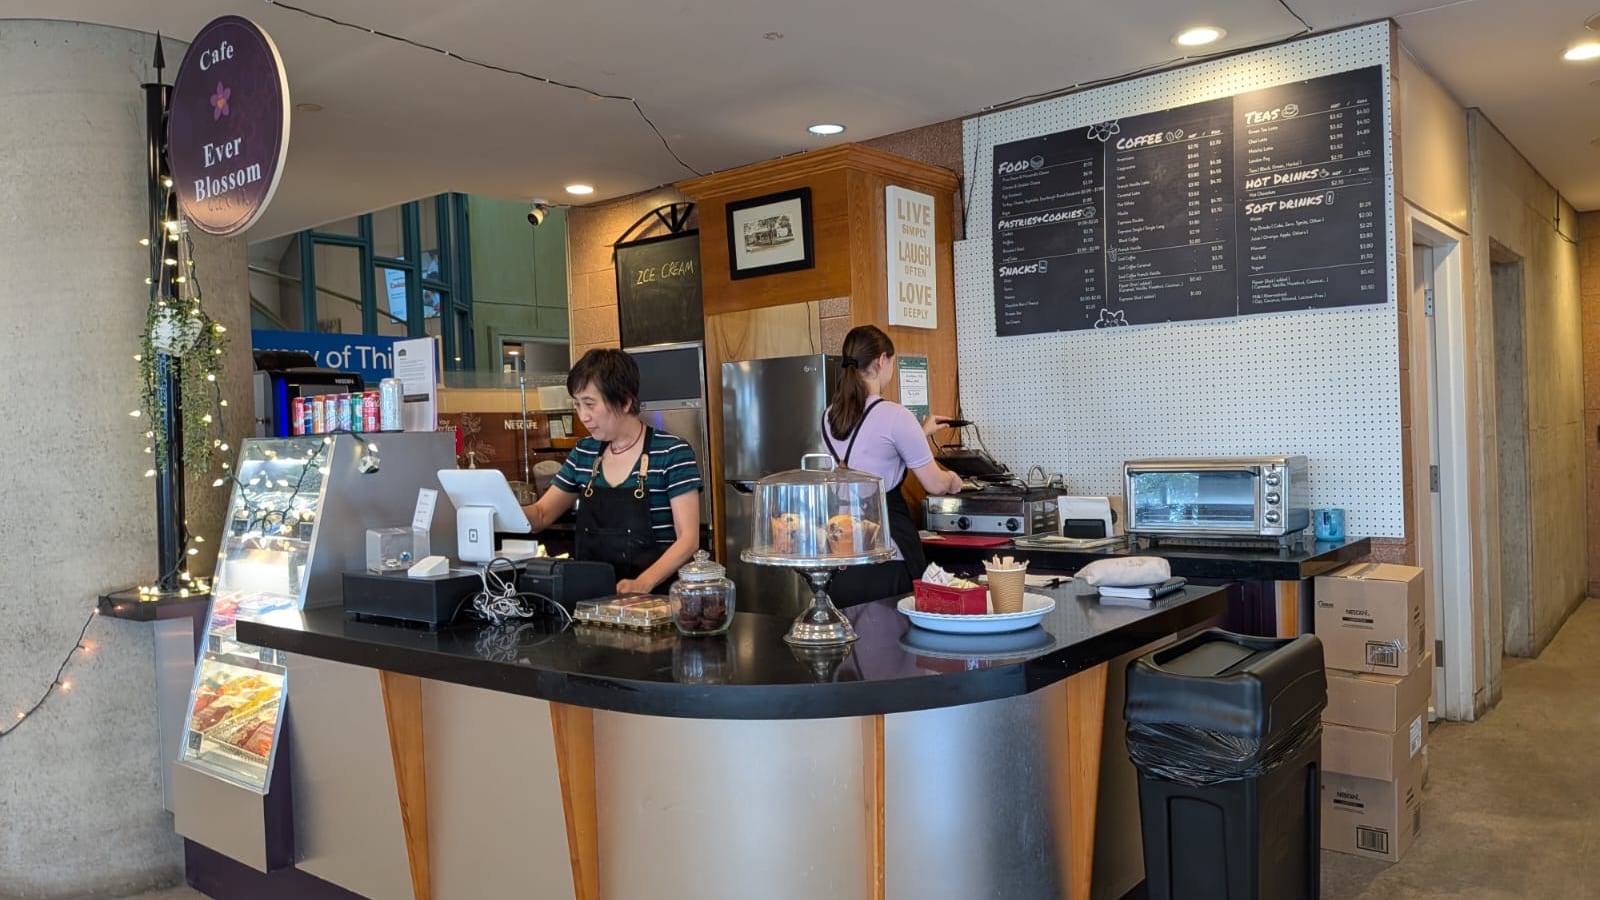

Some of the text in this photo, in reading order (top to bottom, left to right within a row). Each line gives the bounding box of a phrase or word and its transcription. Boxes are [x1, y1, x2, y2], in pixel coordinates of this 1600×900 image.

[199, 40, 235, 72] Cafe
[1244, 108, 1281, 125] TEAS
[1116, 132, 1164, 150] COFFEE
[202, 136, 243, 168] Ever
[998, 160, 1030, 175] FOOD
[194, 162, 262, 203] Blossom
[1246, 177, 1272, 190] HOT
[1273, 168, 1320, 184] DRINKS
[897, 198, 930, 226] LIVE
[1245, 195, 1324, 215] SOFT DRINKS
[901, 223, 928, 239] SIMPLY
[898, 239, 931, 267] LAUGH
[661, 259, 694, 279] CREAM
[904, 265, 927, 279] OFTEN
[999, 263, 1039, 278] SNACKS
[898, 281, 932, 307] LOVE
[903, 307, 929, 321] DEEPLY
[325, 345, 351, 370] of
